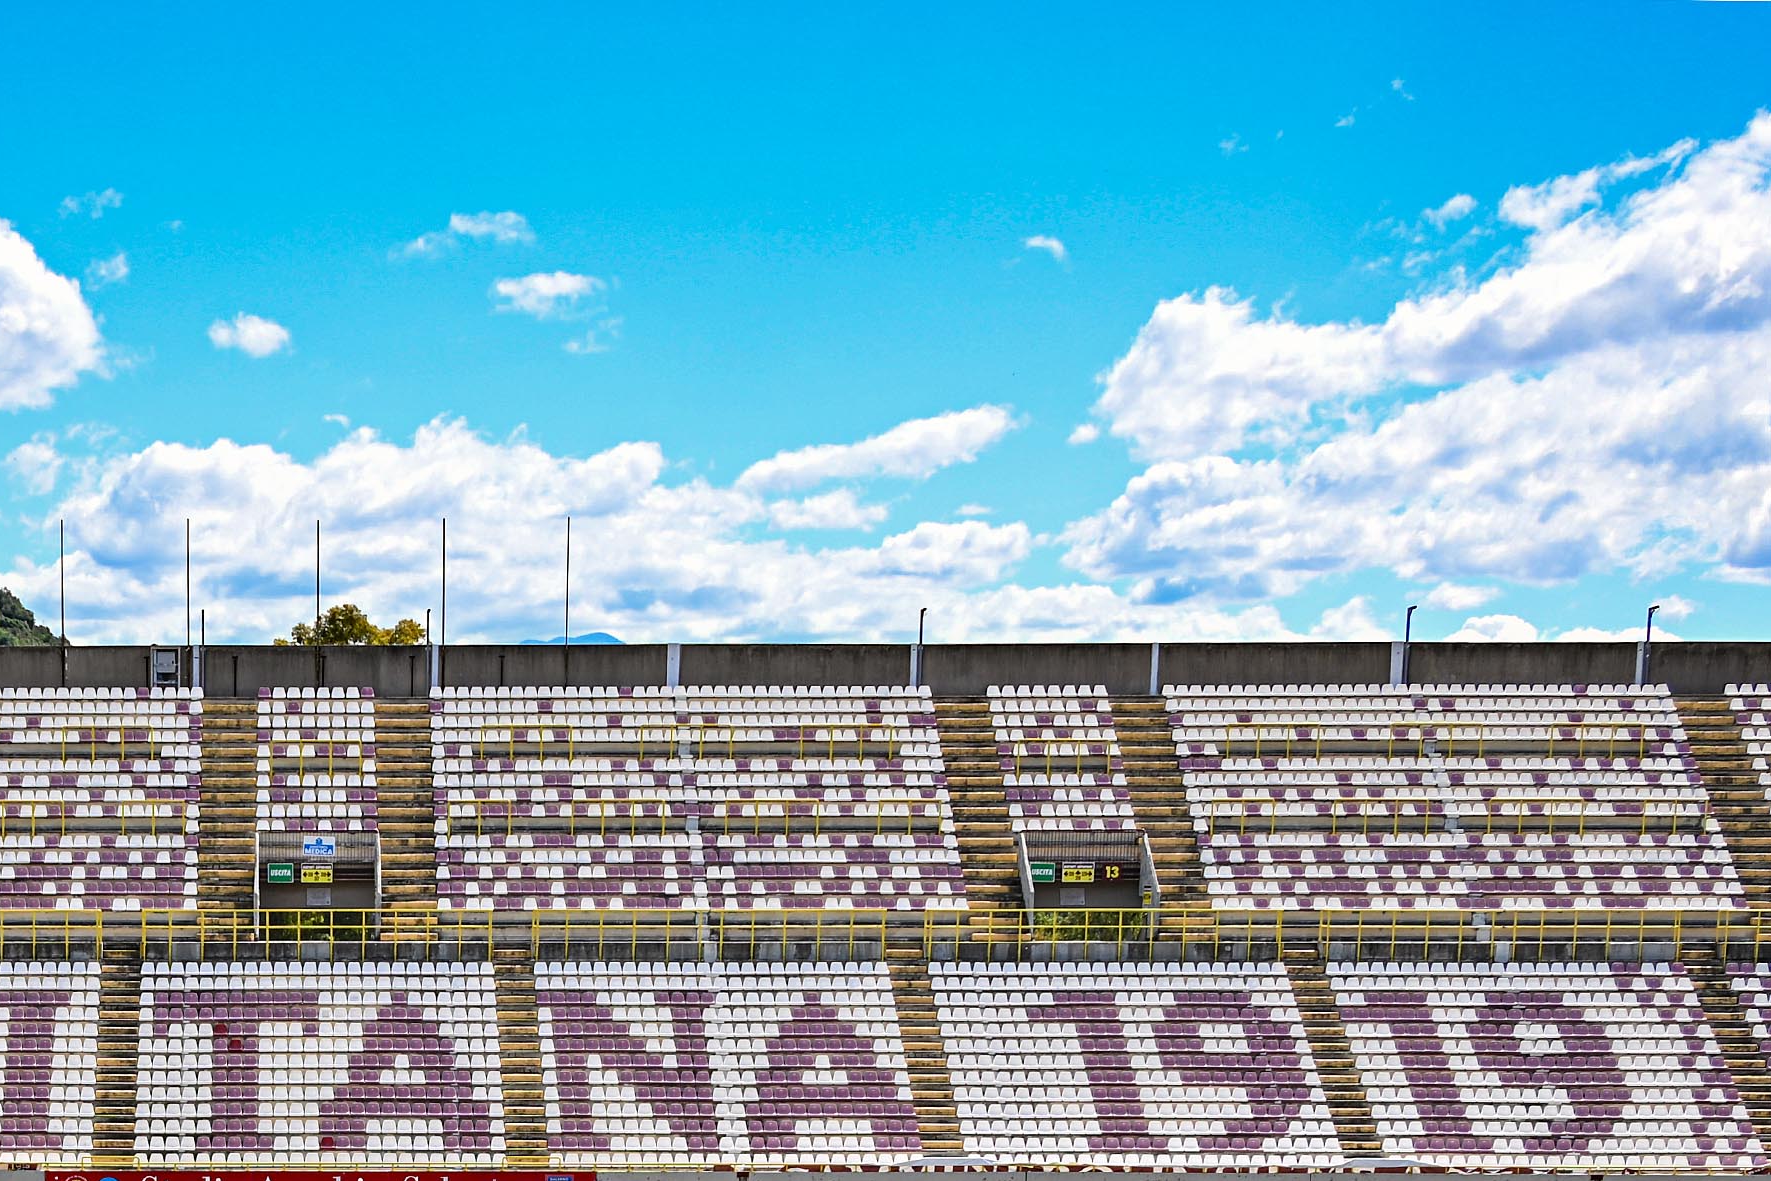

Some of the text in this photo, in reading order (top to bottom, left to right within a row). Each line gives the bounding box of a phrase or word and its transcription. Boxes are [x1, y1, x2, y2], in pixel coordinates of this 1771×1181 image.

[270, 869, 291, 877] USCITA
[1031, 868, 1053, 876] USCITA
[1105, 866, 1120, 878] 13
[1027, 992, 1635, 1153] 1919
